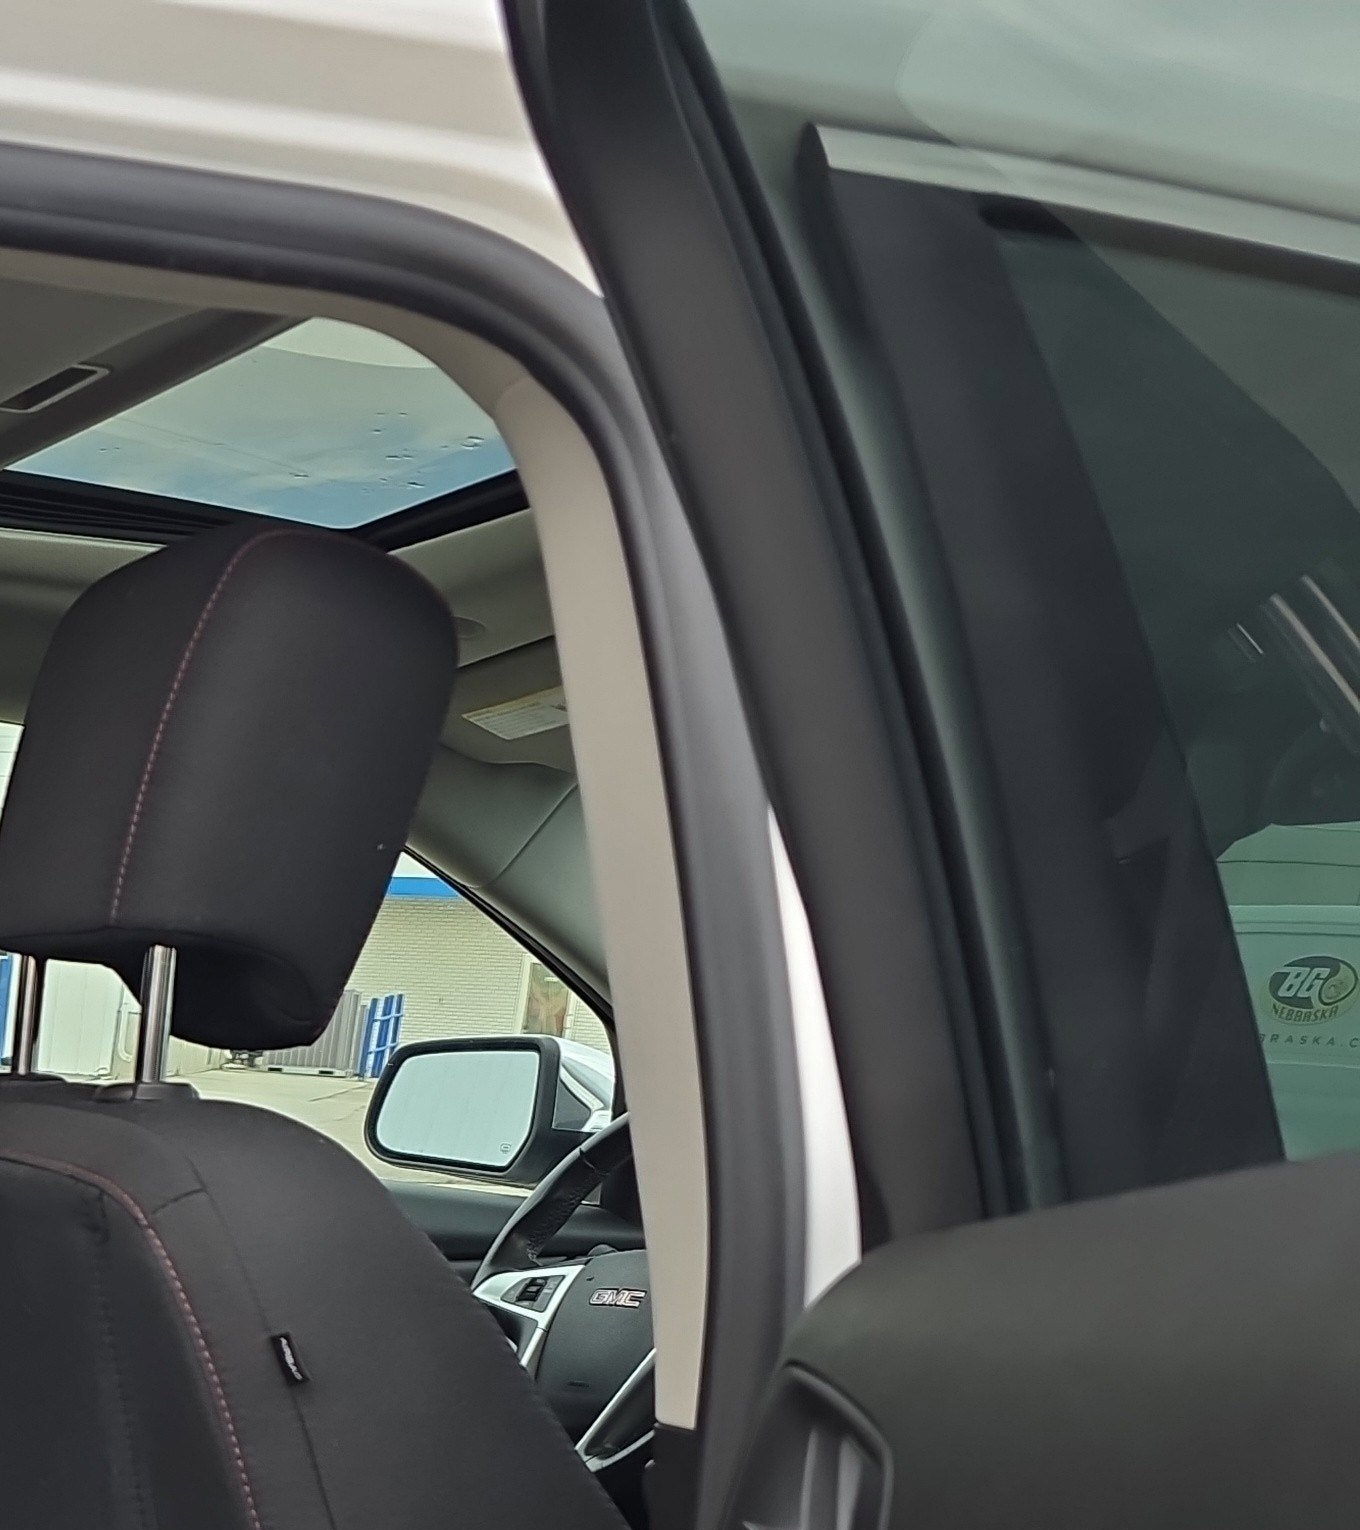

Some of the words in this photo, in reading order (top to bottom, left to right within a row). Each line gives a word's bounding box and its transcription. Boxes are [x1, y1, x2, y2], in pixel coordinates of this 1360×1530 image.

[1277, 966, 1331, 998] BG
[1272, 1003, 1339, 1023] NEBRASKA
[589, 1288, 647, 1308] GMC
